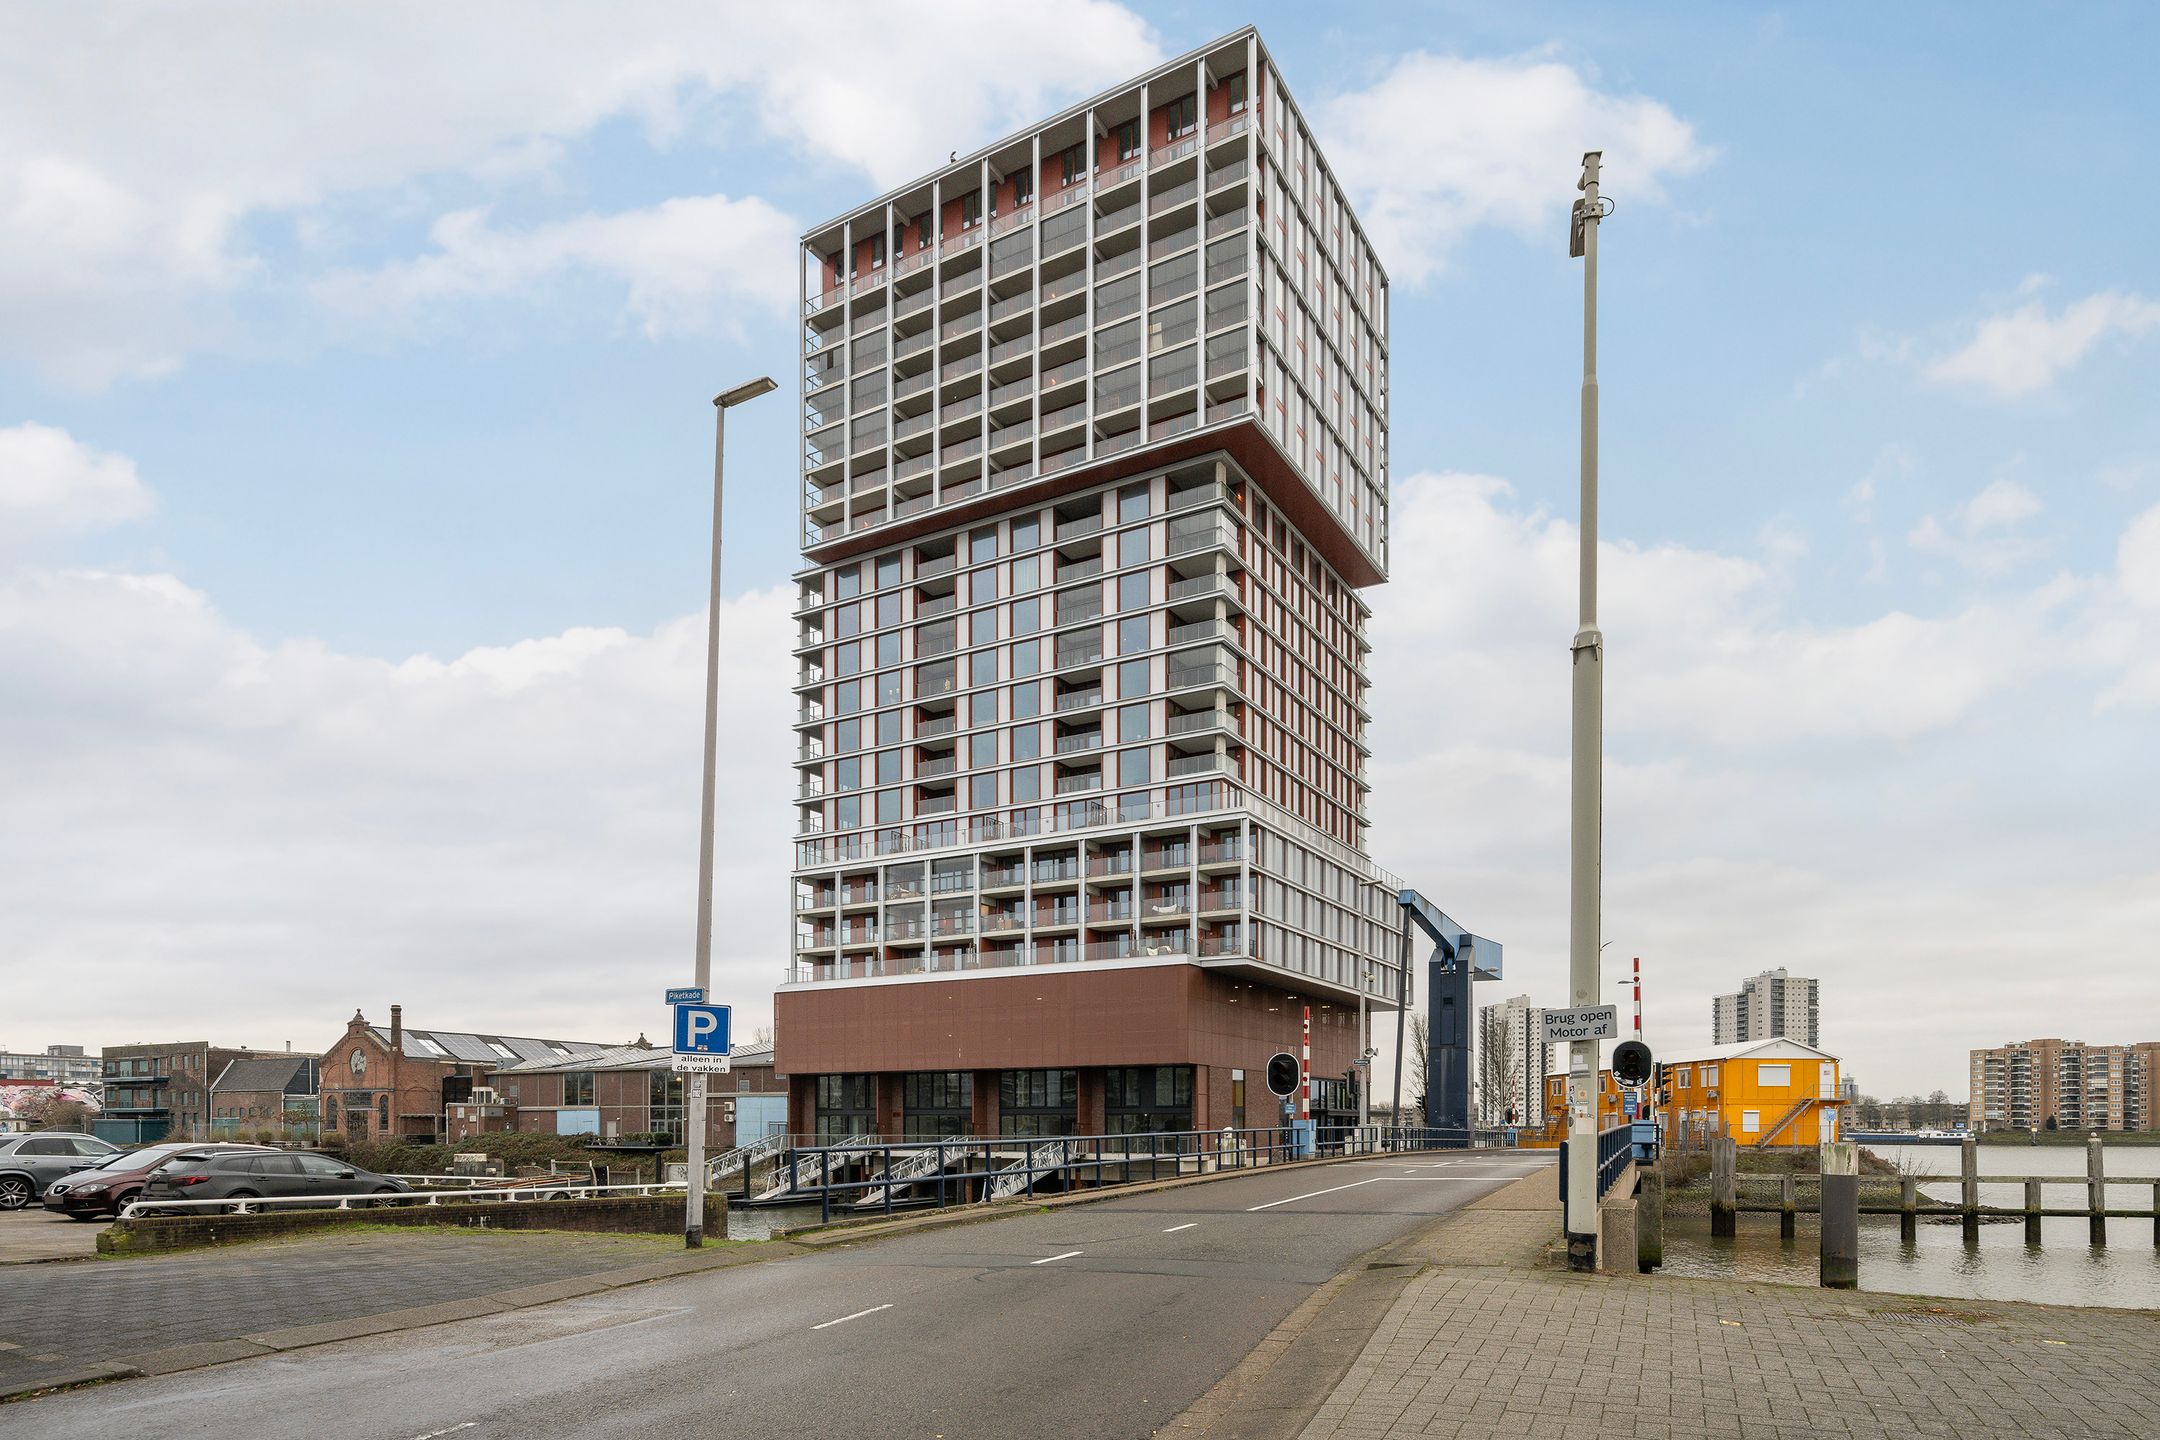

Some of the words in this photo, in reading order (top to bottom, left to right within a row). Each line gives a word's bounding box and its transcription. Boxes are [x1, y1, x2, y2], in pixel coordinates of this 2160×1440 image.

[668, 991, 701, 1000] Piketkade
[1545, 1014, 1575, 1025] Brug
[1580, 1011, 1612, 1023] open
[687, 1010, 718, 1047] P
[1550, 1027, 1589, 1038] Motor
[1594, 1023, 1607, 1035] af
[681, 1055, 710, 1063] alleen
[676, 1064, 689, 1072] de
[692, 1065, 726, 1073] vakken
